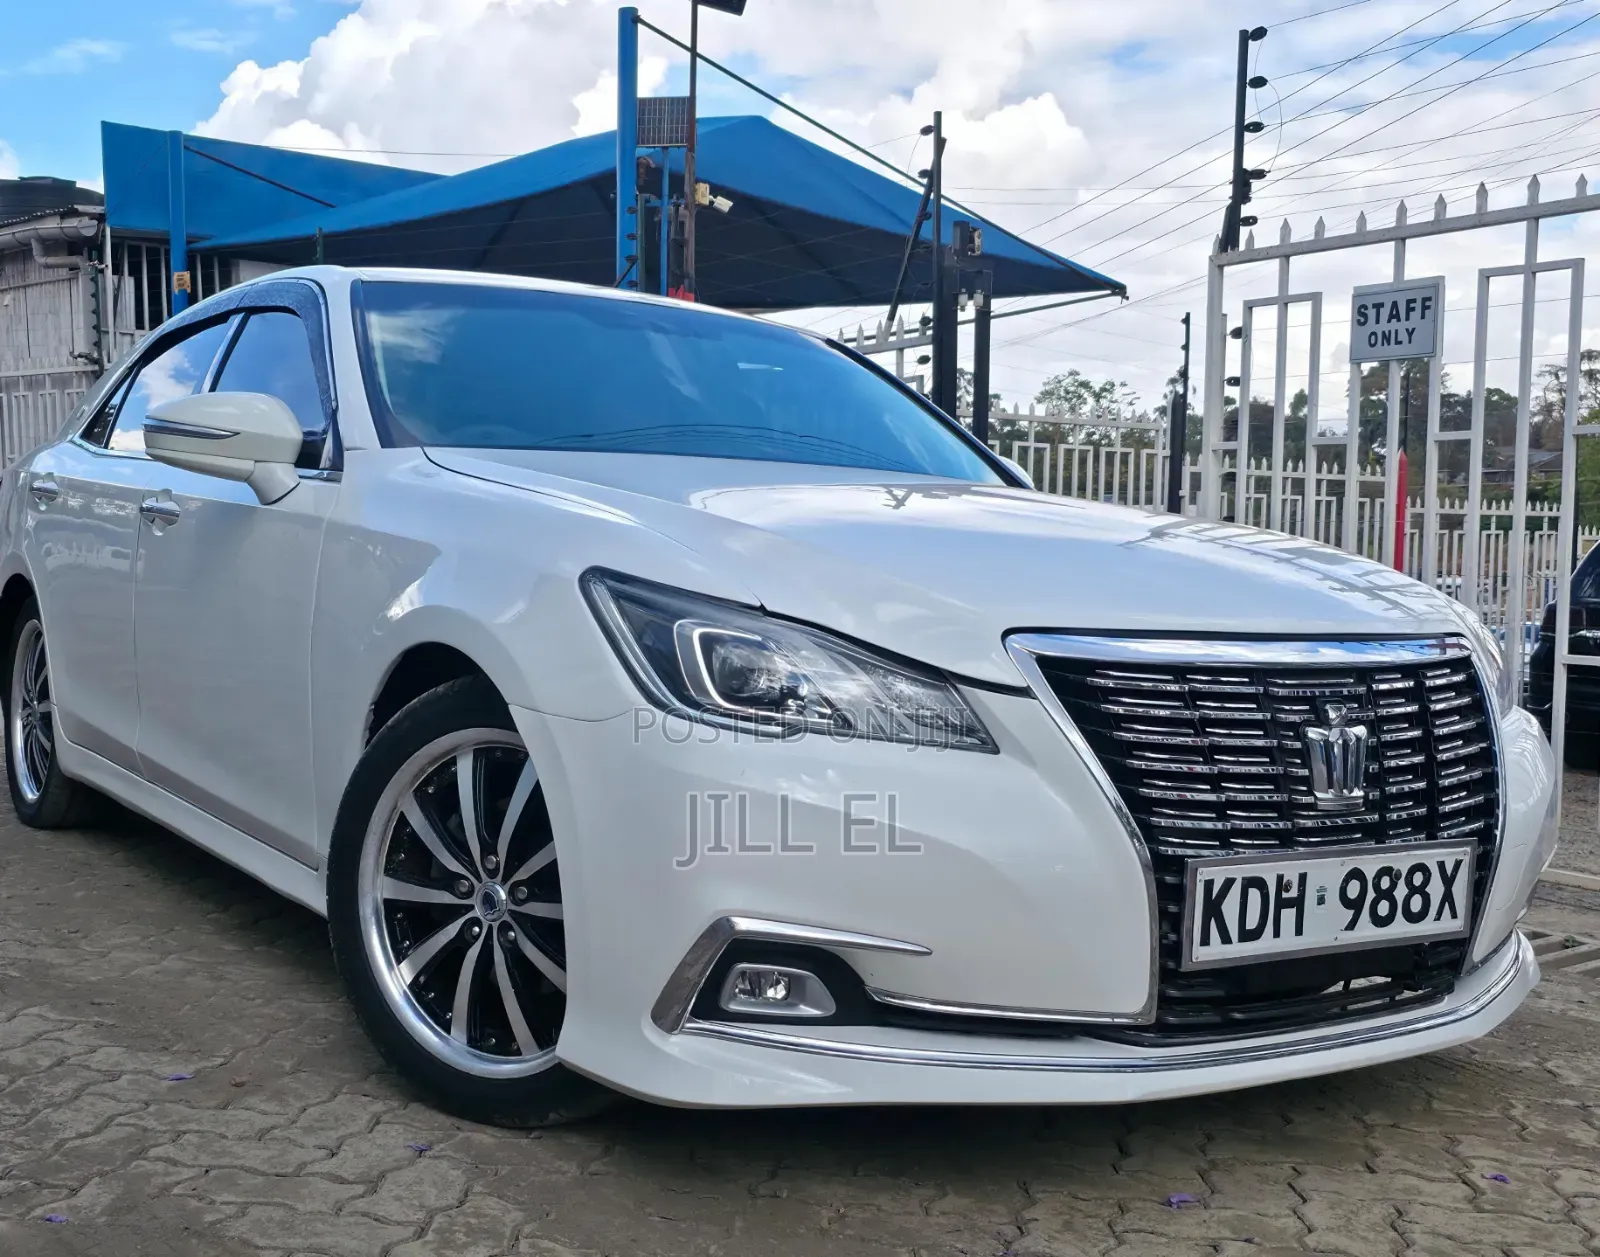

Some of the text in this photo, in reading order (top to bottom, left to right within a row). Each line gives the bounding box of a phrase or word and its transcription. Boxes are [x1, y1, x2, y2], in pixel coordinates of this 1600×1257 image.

[1356, 296, 1432, 326] STAFF
[1368, 327, 1416, 348] ONLY
[1199, 859, 1463, 947] KDH 988X
